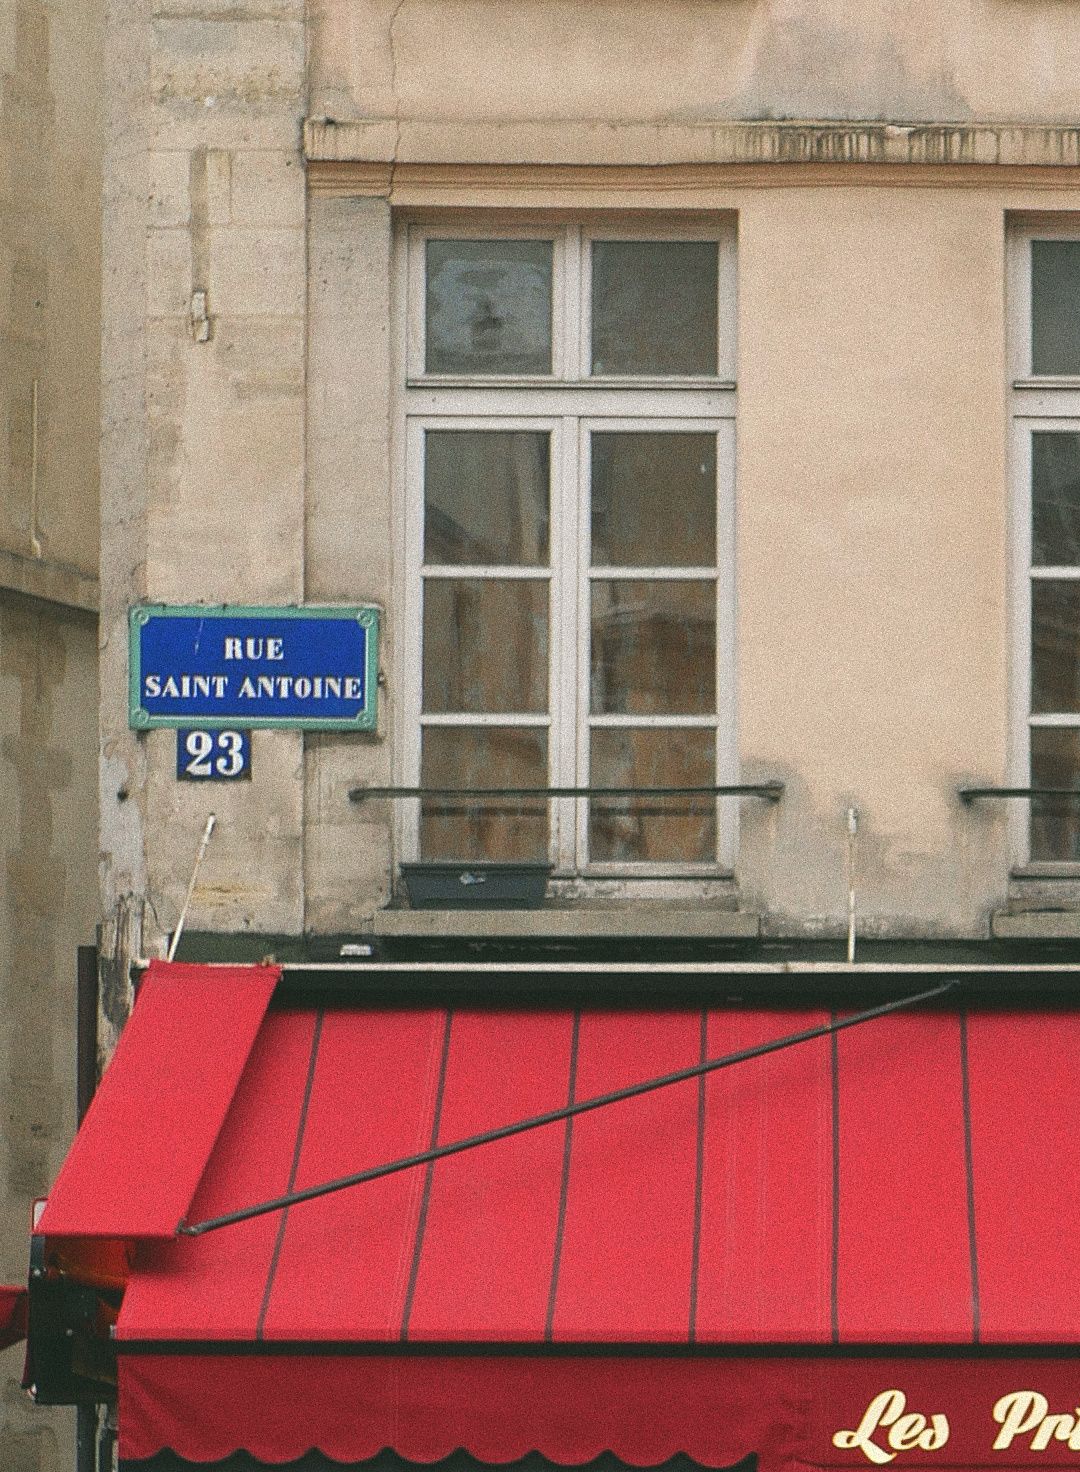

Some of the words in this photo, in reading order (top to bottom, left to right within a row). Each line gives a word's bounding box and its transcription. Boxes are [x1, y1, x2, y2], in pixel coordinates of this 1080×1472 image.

[224, 638, 284, 660] RUE
[145, 676, 228, 698] SAINT
[238, 677, 362, 699] ANTOINE
[185, 731, 244, 776] 23
[832, 1389, 950, 1464] Les
